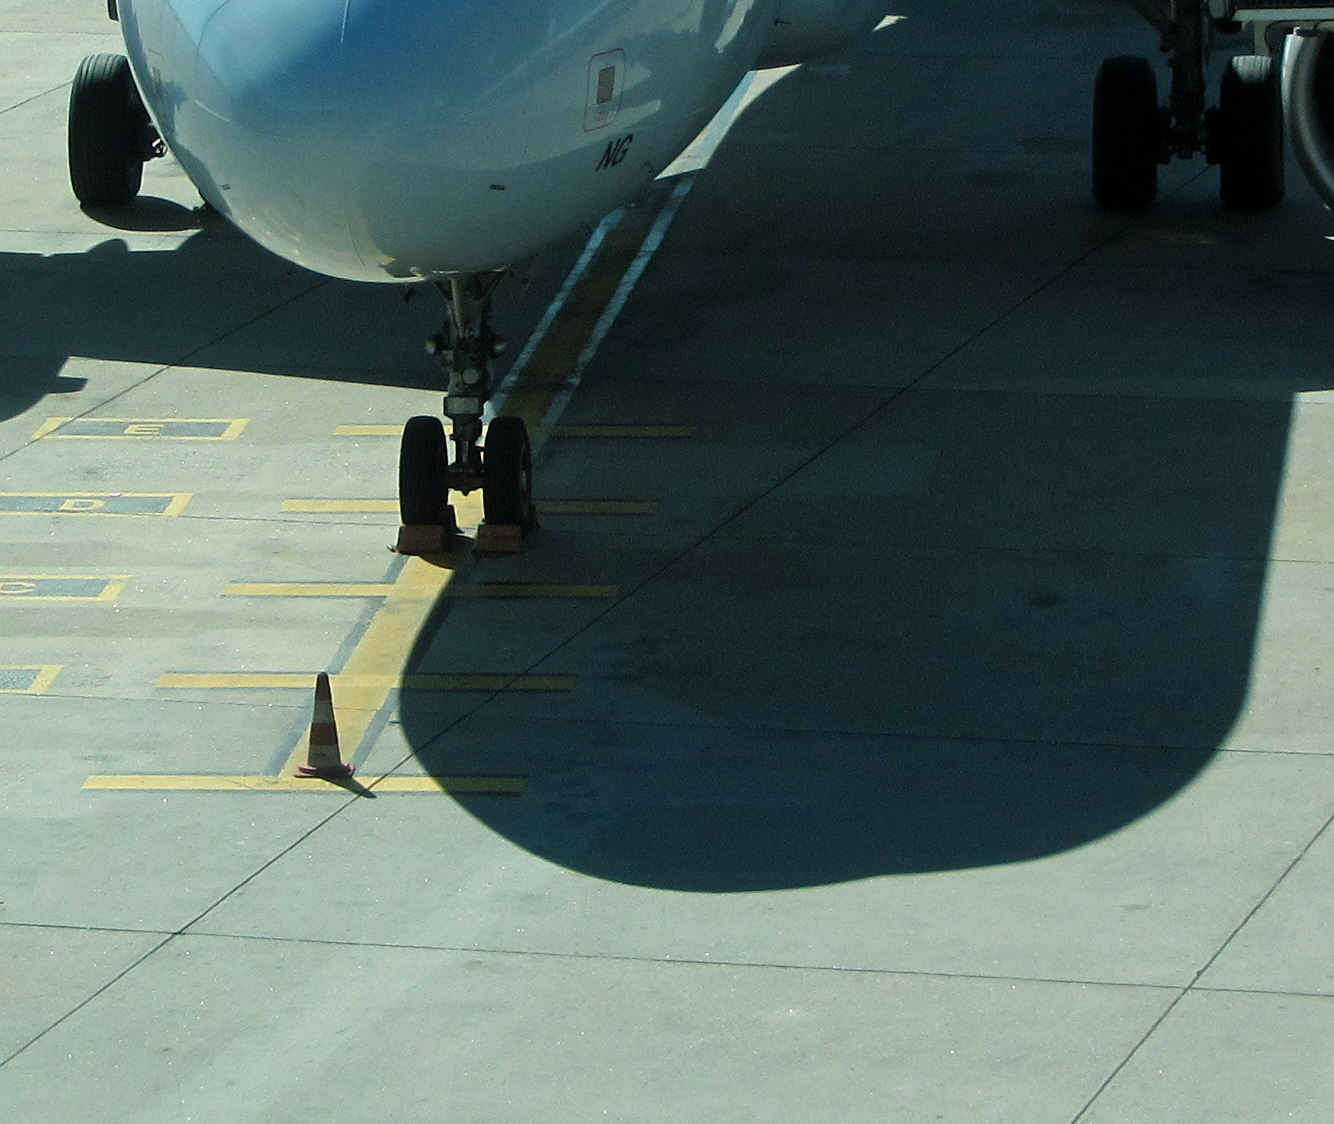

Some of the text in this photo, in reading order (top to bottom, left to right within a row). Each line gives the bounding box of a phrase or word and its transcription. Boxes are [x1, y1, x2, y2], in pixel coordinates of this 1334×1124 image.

[594, 133, 634, 173] NG
[123, 423, 165, 436] E
[58, 498, 107, 511] D
